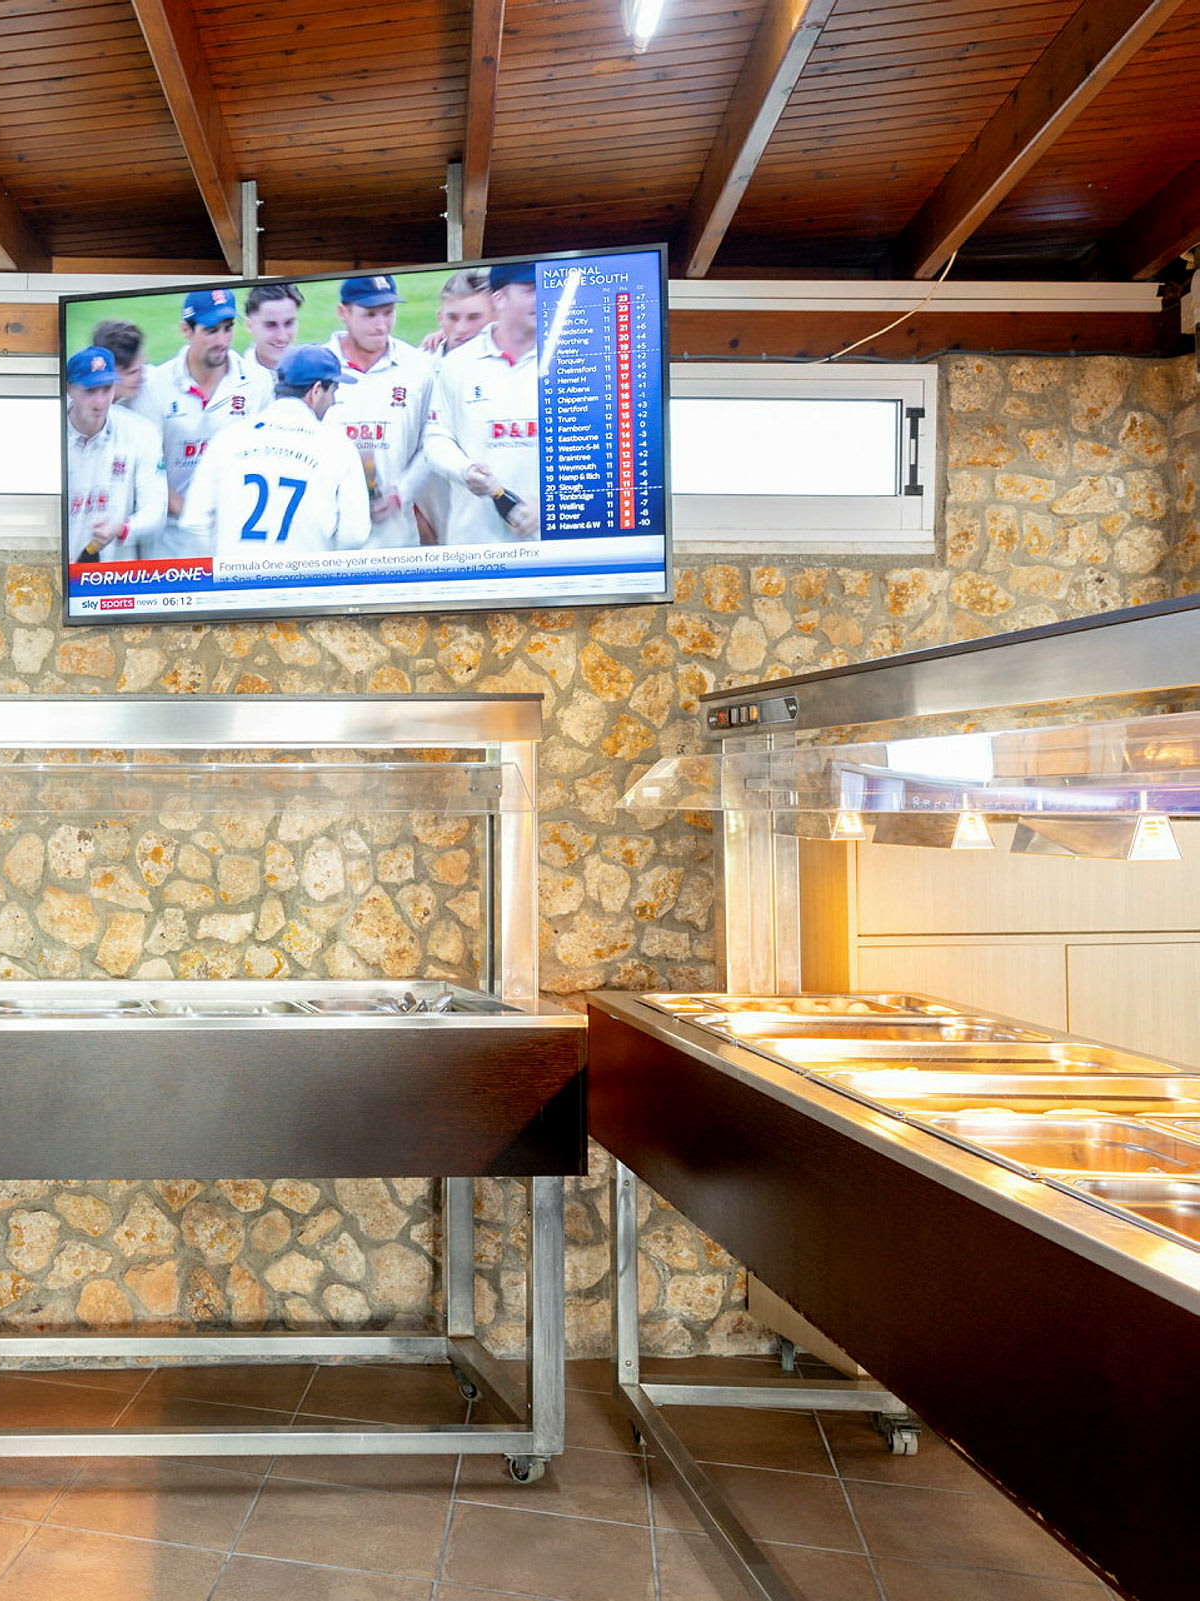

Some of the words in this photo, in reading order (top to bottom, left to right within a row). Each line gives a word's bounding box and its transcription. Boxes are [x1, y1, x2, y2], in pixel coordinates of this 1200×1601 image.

[543, 266, 601, 278] NATIONAL
[543, 276, 586, 288] LEAGE
[590, 273, 628, 285] SOUTH
[557, 366, 597, 375] Chelmsford
[544, 388, 552, 396] 10
[558, 396, 599, 405] Chippenham
[558, 405, 588, 414] Dartford
[558, 444, 600, 452] Weston-S-M
[558, 463, 597, 472] Weymouth
[559, 474, 579, 482] Hamp
[558, 484, 583, 492] Slough
[559, 493, 594, 501] Tonbridge
[241, 474, 306, 541] 27
[559, 503, 585, 511] Welling
[560, 522, 586, 530] Havant
[219, 561, 260, 572] Formula
[261, 559, 284, 570] One
[285, 559, 320, 570] agrees
[322, 556, 368, 568] one-year
[370, 554, 422, 565] extension
[425, 552, 440, 562] for
[442, 550, 481, 564] Belgian
[483, 548, 517, 560] Grand
[519, 548, 540, 558] Prix
[80, 569, 161, 586] FORMULA
[165, 566, 204, 582] ONE
[82, 600, 98, 610] sky
[101, 598, 134, 610] sports
[162, 596, 192, 606] 06:12
